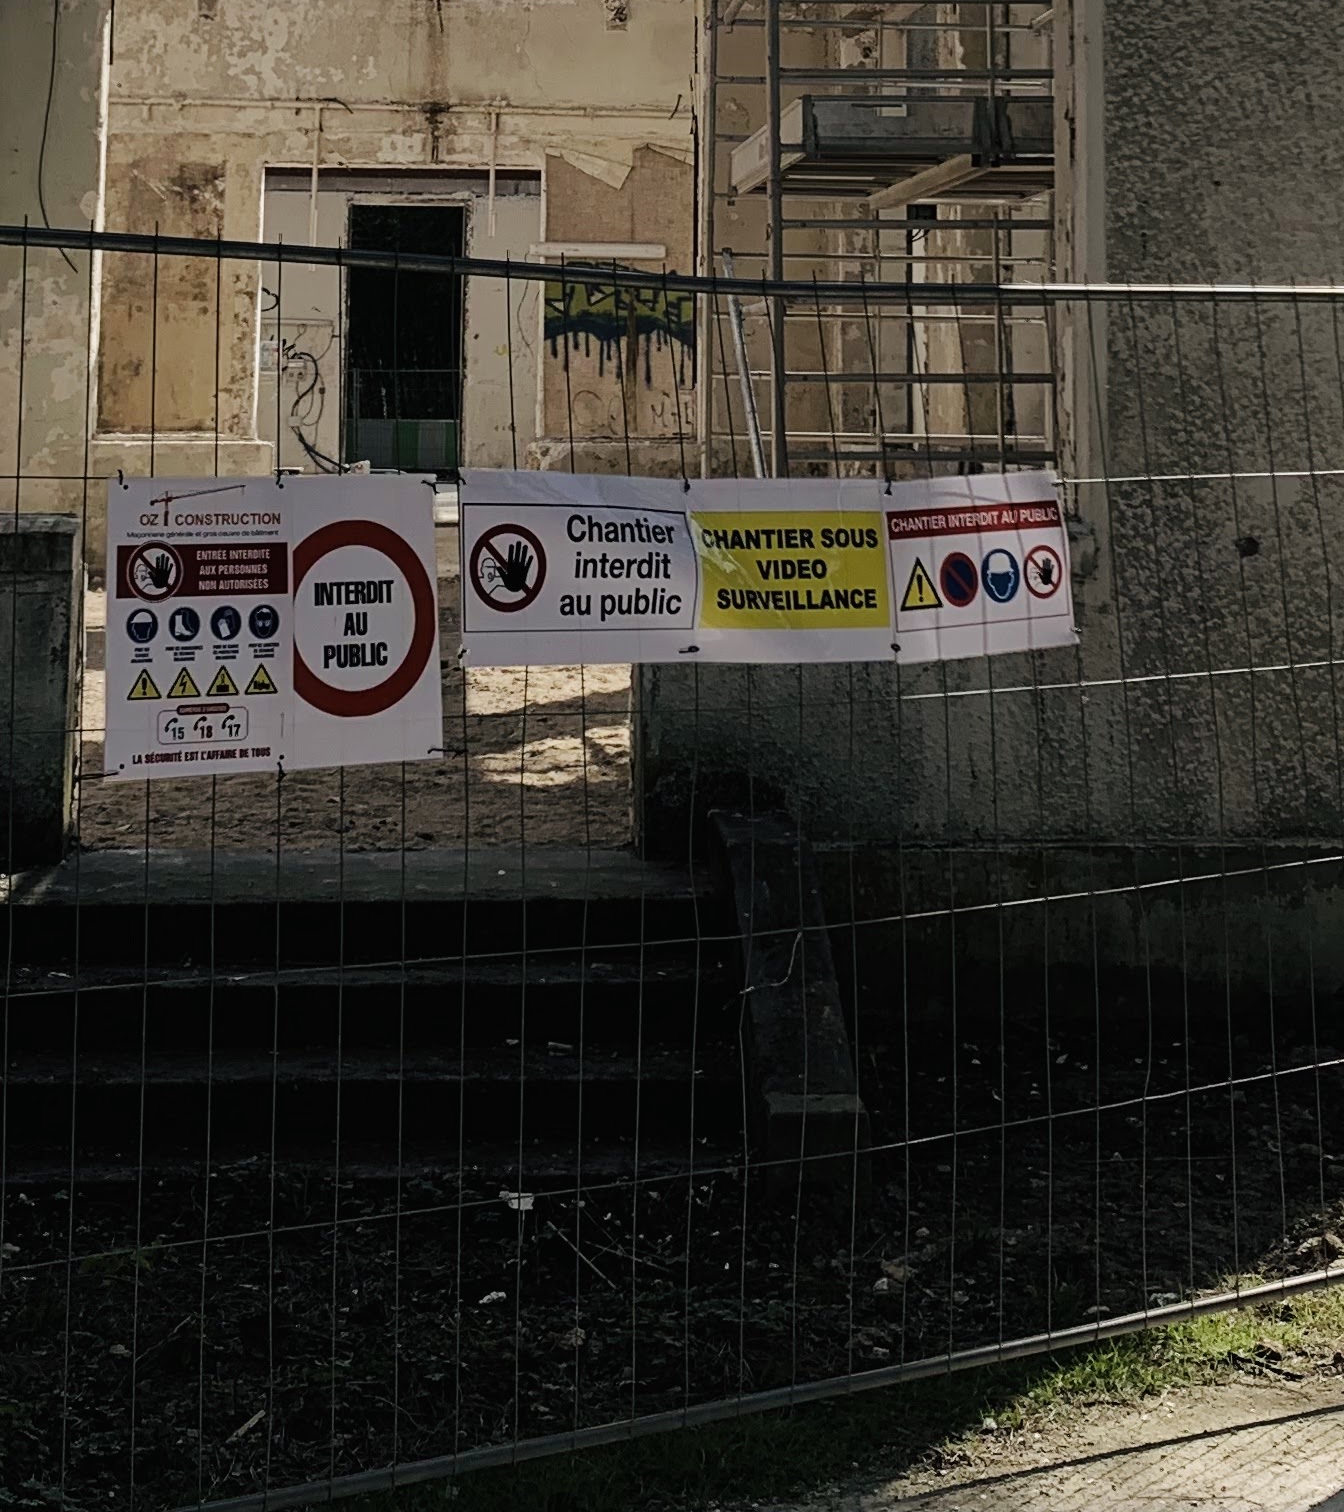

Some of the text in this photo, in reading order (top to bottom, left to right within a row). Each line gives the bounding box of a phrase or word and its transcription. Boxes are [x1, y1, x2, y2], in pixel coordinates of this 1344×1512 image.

[175, 512, 281, 525] CONSTRUCTION
[566, 514, 675, 544] Chantier
[891, 507, 1058, 533] CHANTIER INTERDIT AU PUBLIC
[702, 528, 878, 549] CHANTIER SOUS
[196, 547, 271, 561] ENTRÉE INTERDITE
[199, 564, 268, 575] AUX PERSONNES
[575, 552, 671, 579] interdit
[756, 559, 827, 580] VIDEO
[198, 578, 269, 591] NON AUTORISÉES
[314, 580, 394, 606] INTERDIT
[560, 588, 682, 622] au public
[717, 588, 877, 610] SURVEILLANCE
[343, 611, 368, 636] AU
[324, 642, 388, 669] PUBLIC
[171, 723, 241, 740] 15 18 17
[132, 747, 271, 765] LA SÉCURITÉ EST L'AFFAIRE DE TOUS
